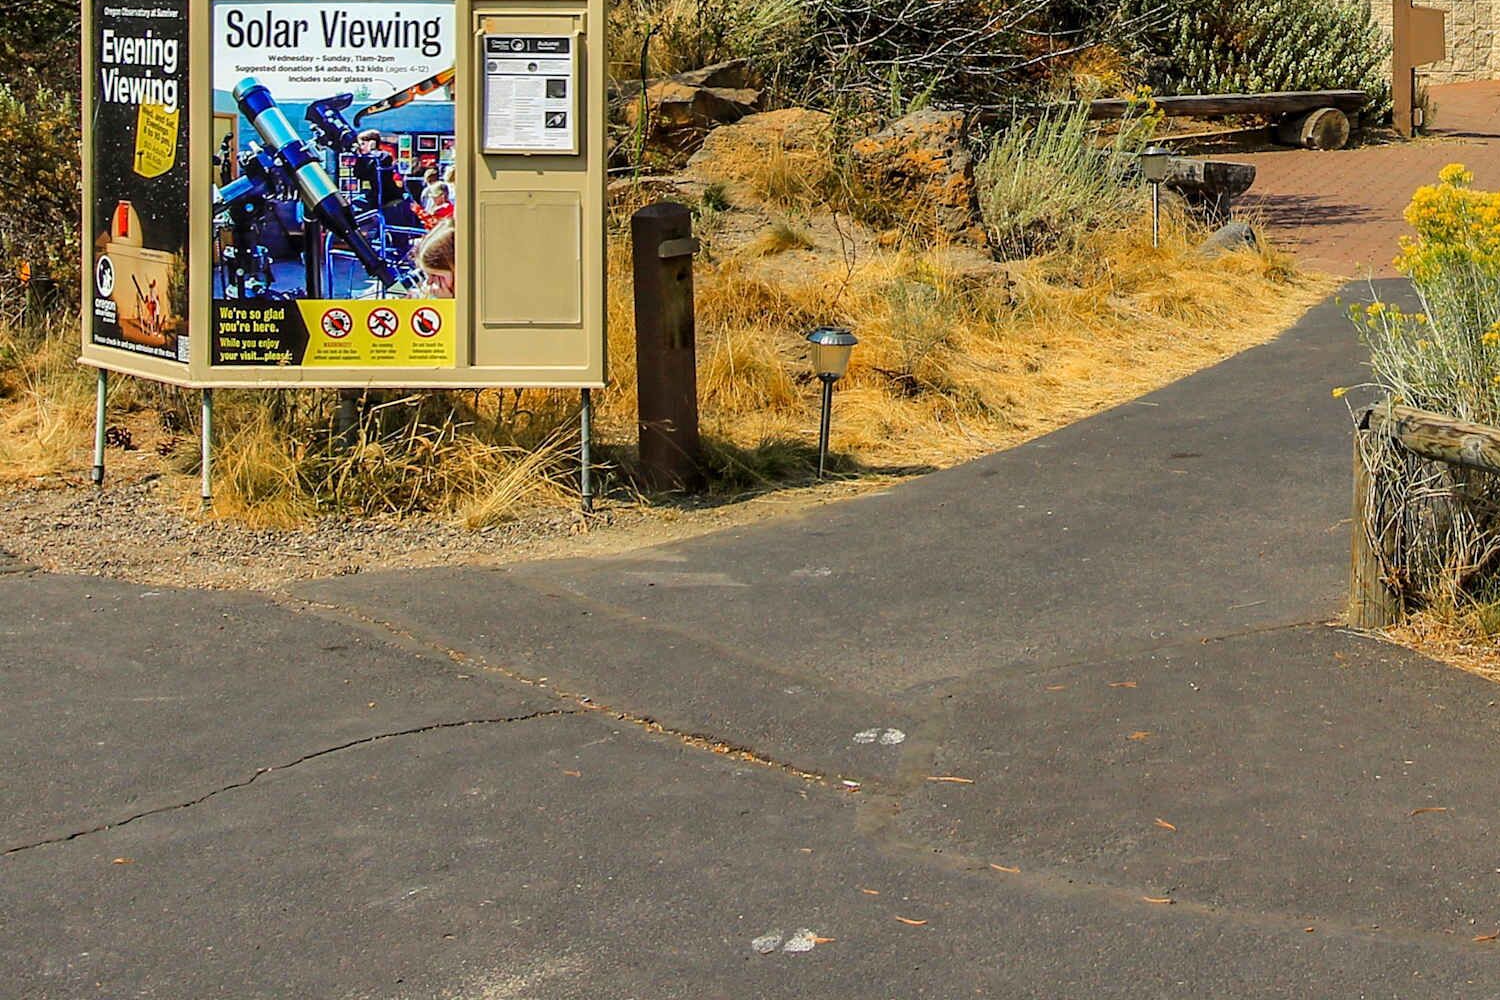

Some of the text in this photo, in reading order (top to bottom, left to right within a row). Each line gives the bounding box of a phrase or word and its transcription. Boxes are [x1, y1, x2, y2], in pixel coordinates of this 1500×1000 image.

[226, 9, 441, 57] Solar Viewing
[102, 29, 178, 74] Evening
[268, 55, 313, 63] Wednesday
[322, 55, 353, 63] Sunday,
[355, 55, 395, 63] 11am-2pm
[235, 65, 276, 73] Suggested
[327, 65, 353, 73] adults,
[344, 75, 373, 84] glasses
[101, 67, 178, 114] Viewing
[219, 307, 285, 322] We're so glad
[219, 320, 279, 334] you're here.
[219, 337, 280, 350] While you enjoy
[220, 352, 239, 362] your
